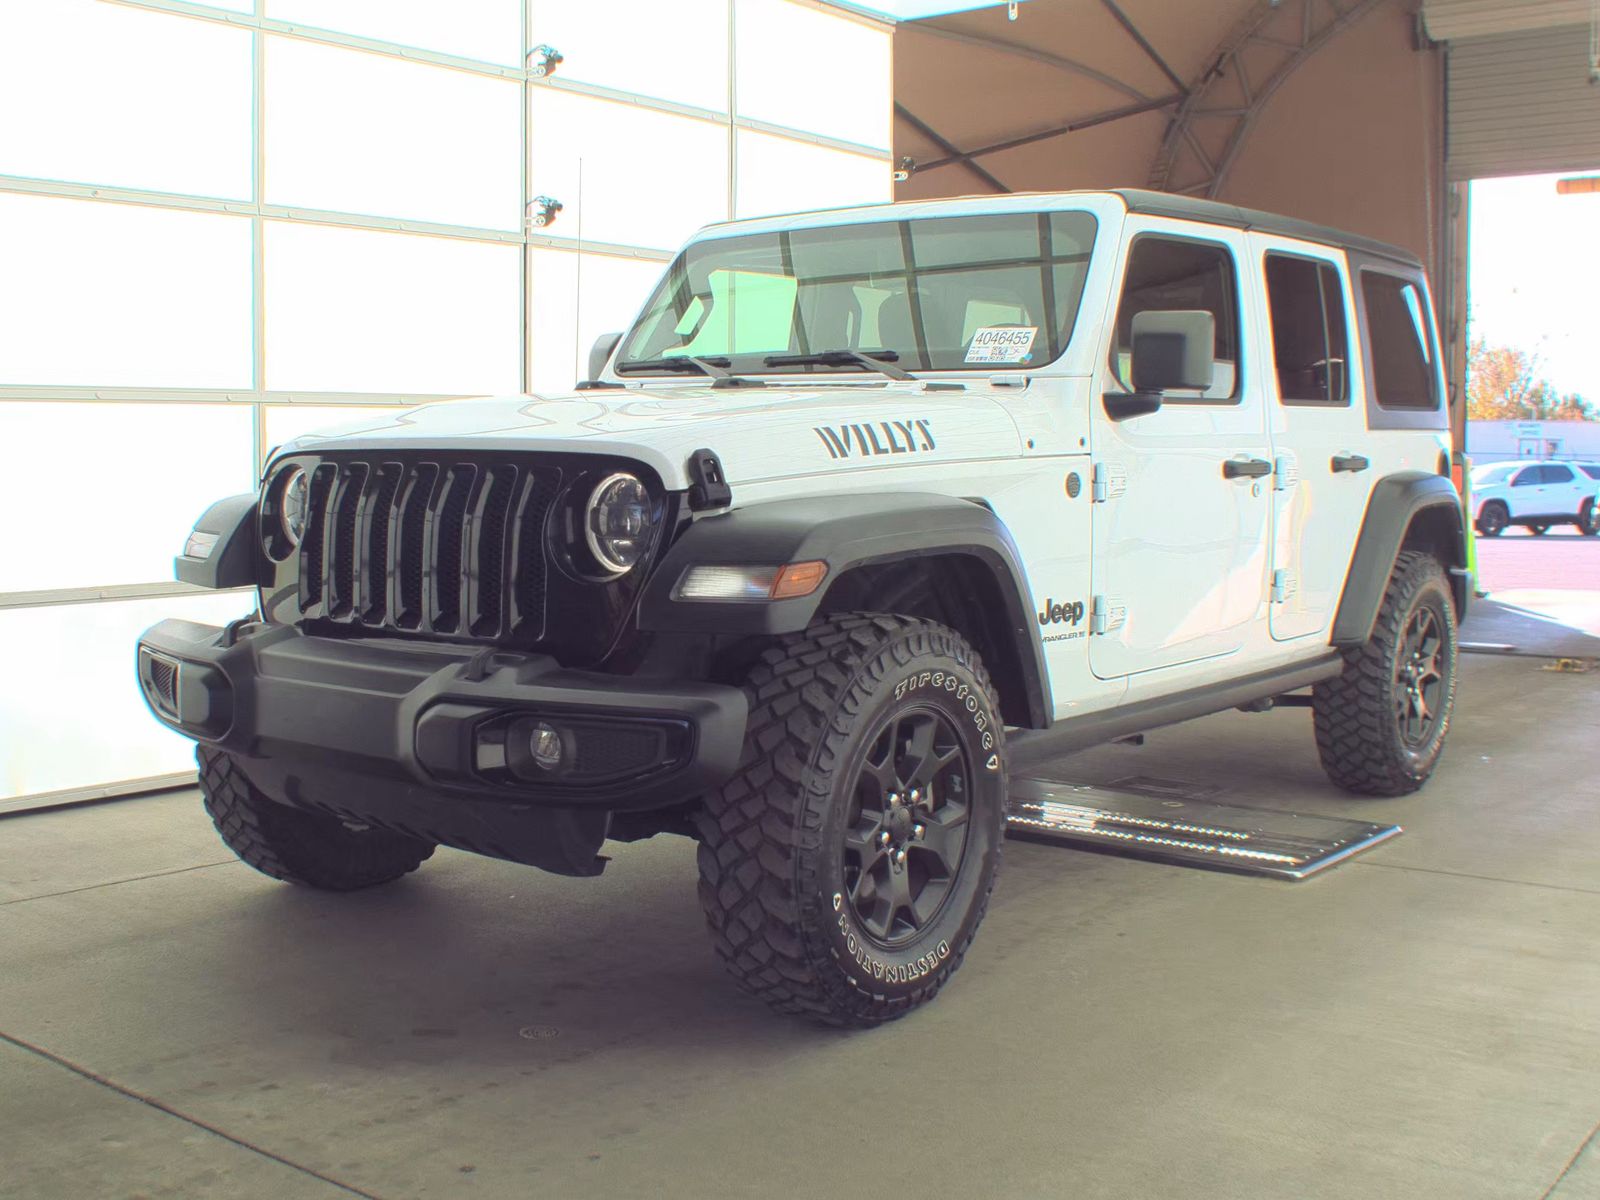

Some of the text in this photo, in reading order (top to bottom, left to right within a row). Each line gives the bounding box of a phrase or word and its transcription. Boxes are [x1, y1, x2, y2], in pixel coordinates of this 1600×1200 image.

[975, 331, 1032, 345] 4046455
[812, 419, 936, 459] WILLYS
[1039, 598, 1084, 626] Jeep
[838, 913, 950, 984] DESTINATION
